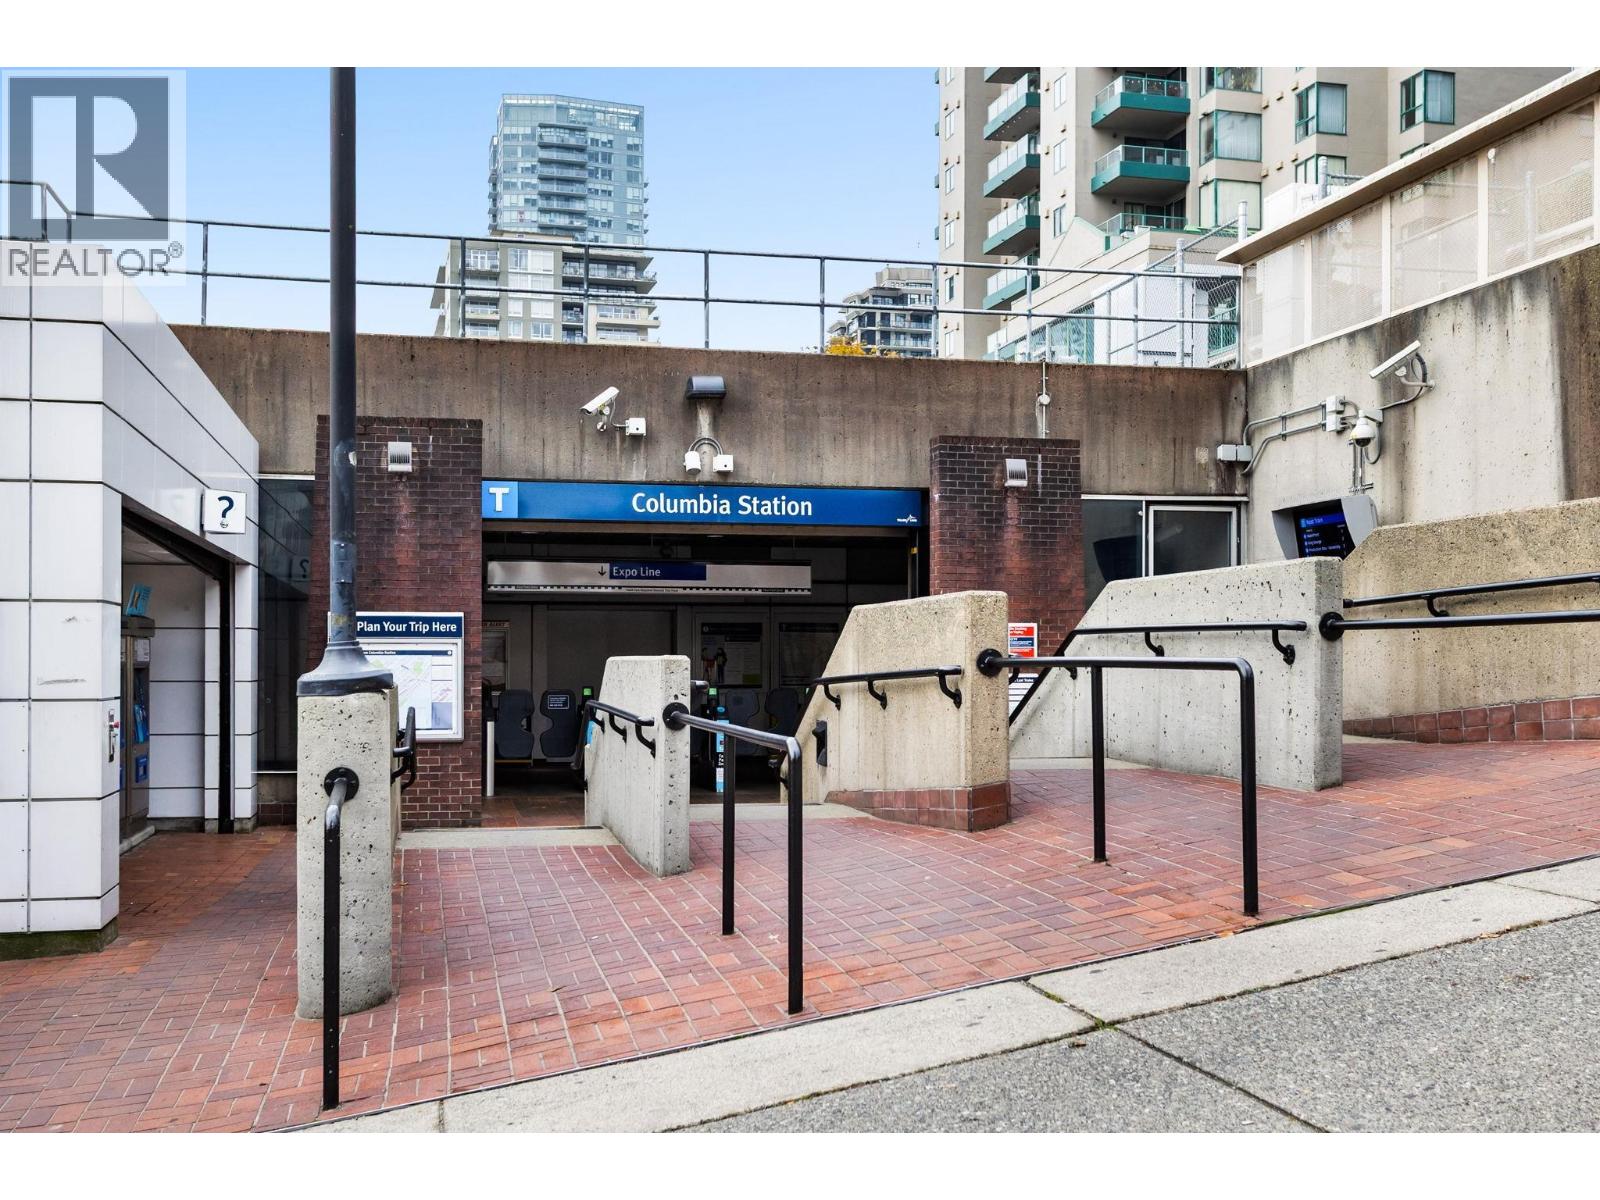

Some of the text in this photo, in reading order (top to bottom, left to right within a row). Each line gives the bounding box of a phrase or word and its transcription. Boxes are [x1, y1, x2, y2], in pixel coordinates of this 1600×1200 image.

[489, 487, 510, 512] T
[631, 492, 813, 516] Columbia Station
[612, 566, 661, 578] Expo Line
[356, 620, 457, 635] Plan Your Trip Here
